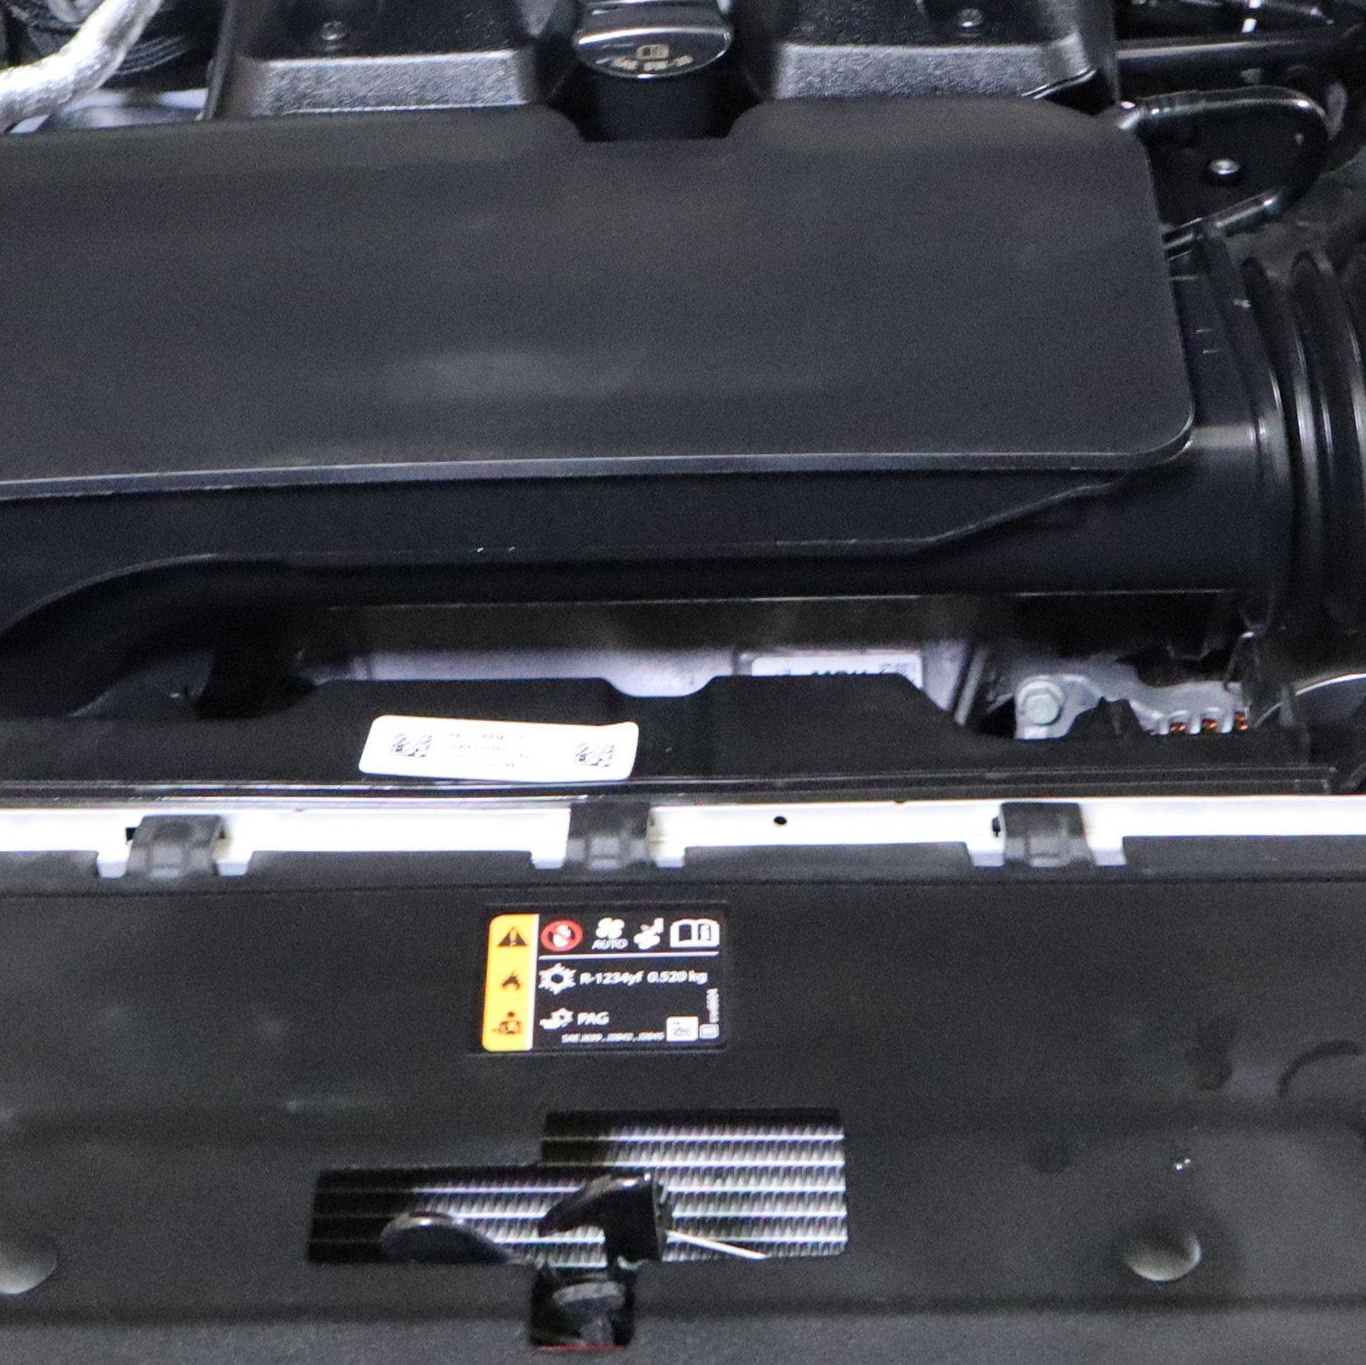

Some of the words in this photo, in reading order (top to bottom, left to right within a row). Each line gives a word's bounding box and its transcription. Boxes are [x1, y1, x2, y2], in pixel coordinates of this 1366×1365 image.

[592, 938, 629, 950] AUTO
[688, 970, 709, 985] kg
[577, 1011, 610, 1025] PAG
